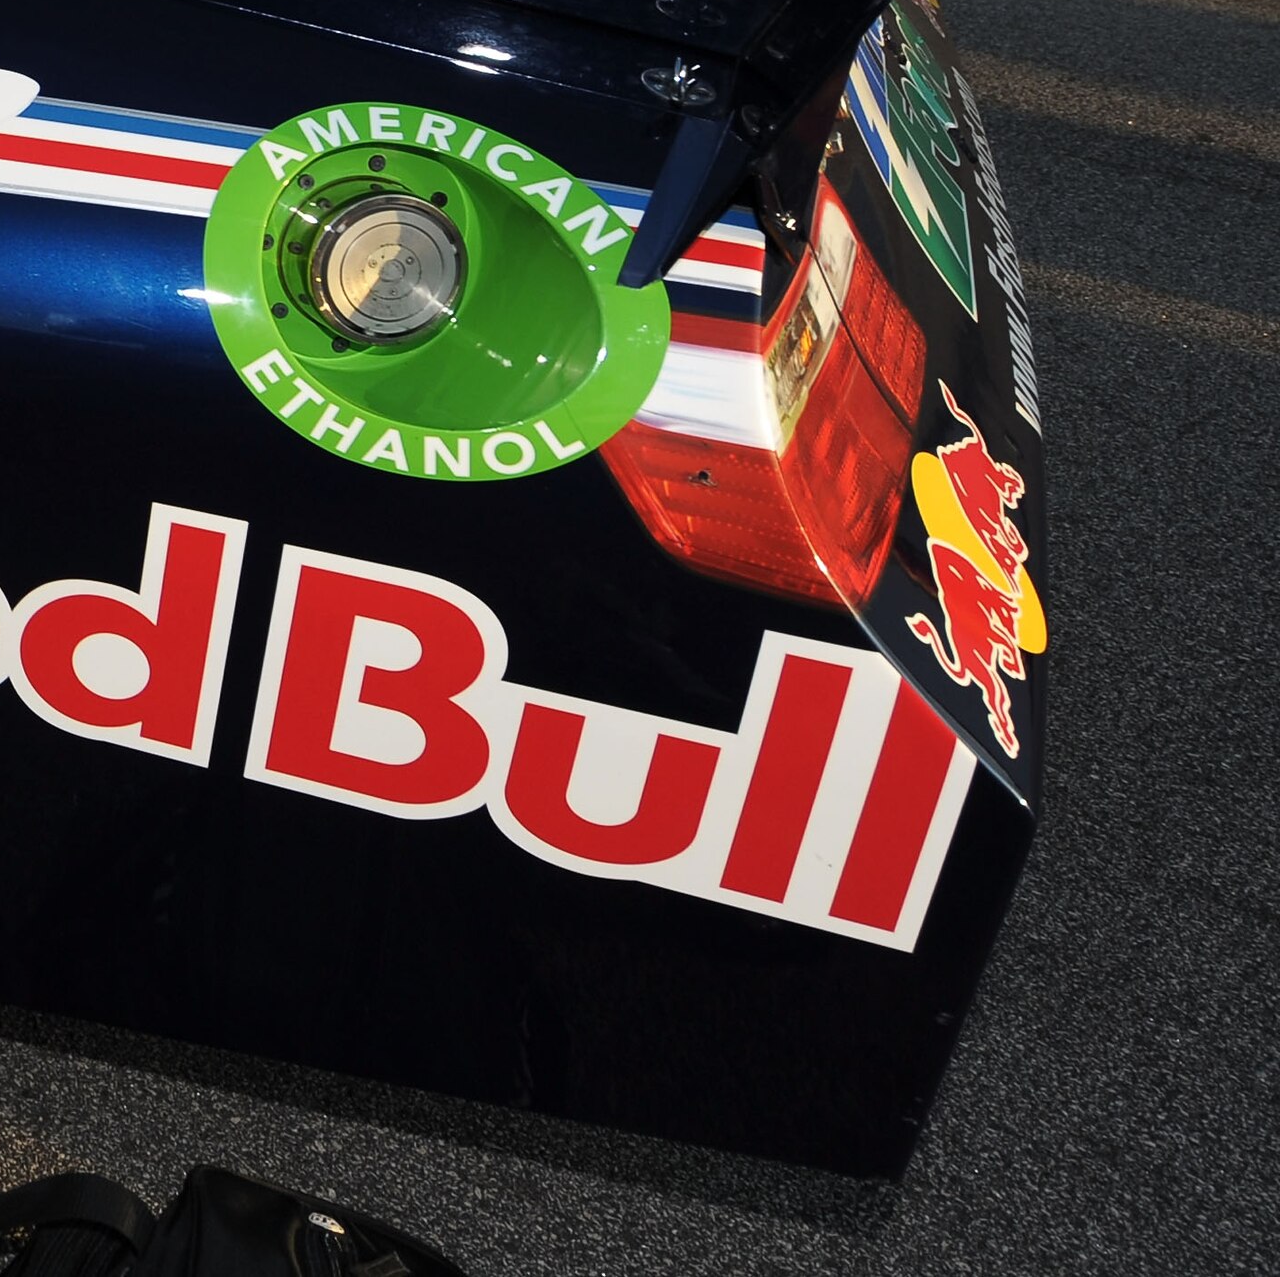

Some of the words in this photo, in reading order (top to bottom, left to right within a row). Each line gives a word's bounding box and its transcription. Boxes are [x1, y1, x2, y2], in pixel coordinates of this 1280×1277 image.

[258, 105, 629, 257] AMERICAN
[240, 348, 587, 478] ETHANOL
[243, 543, 978, 955] Bull
